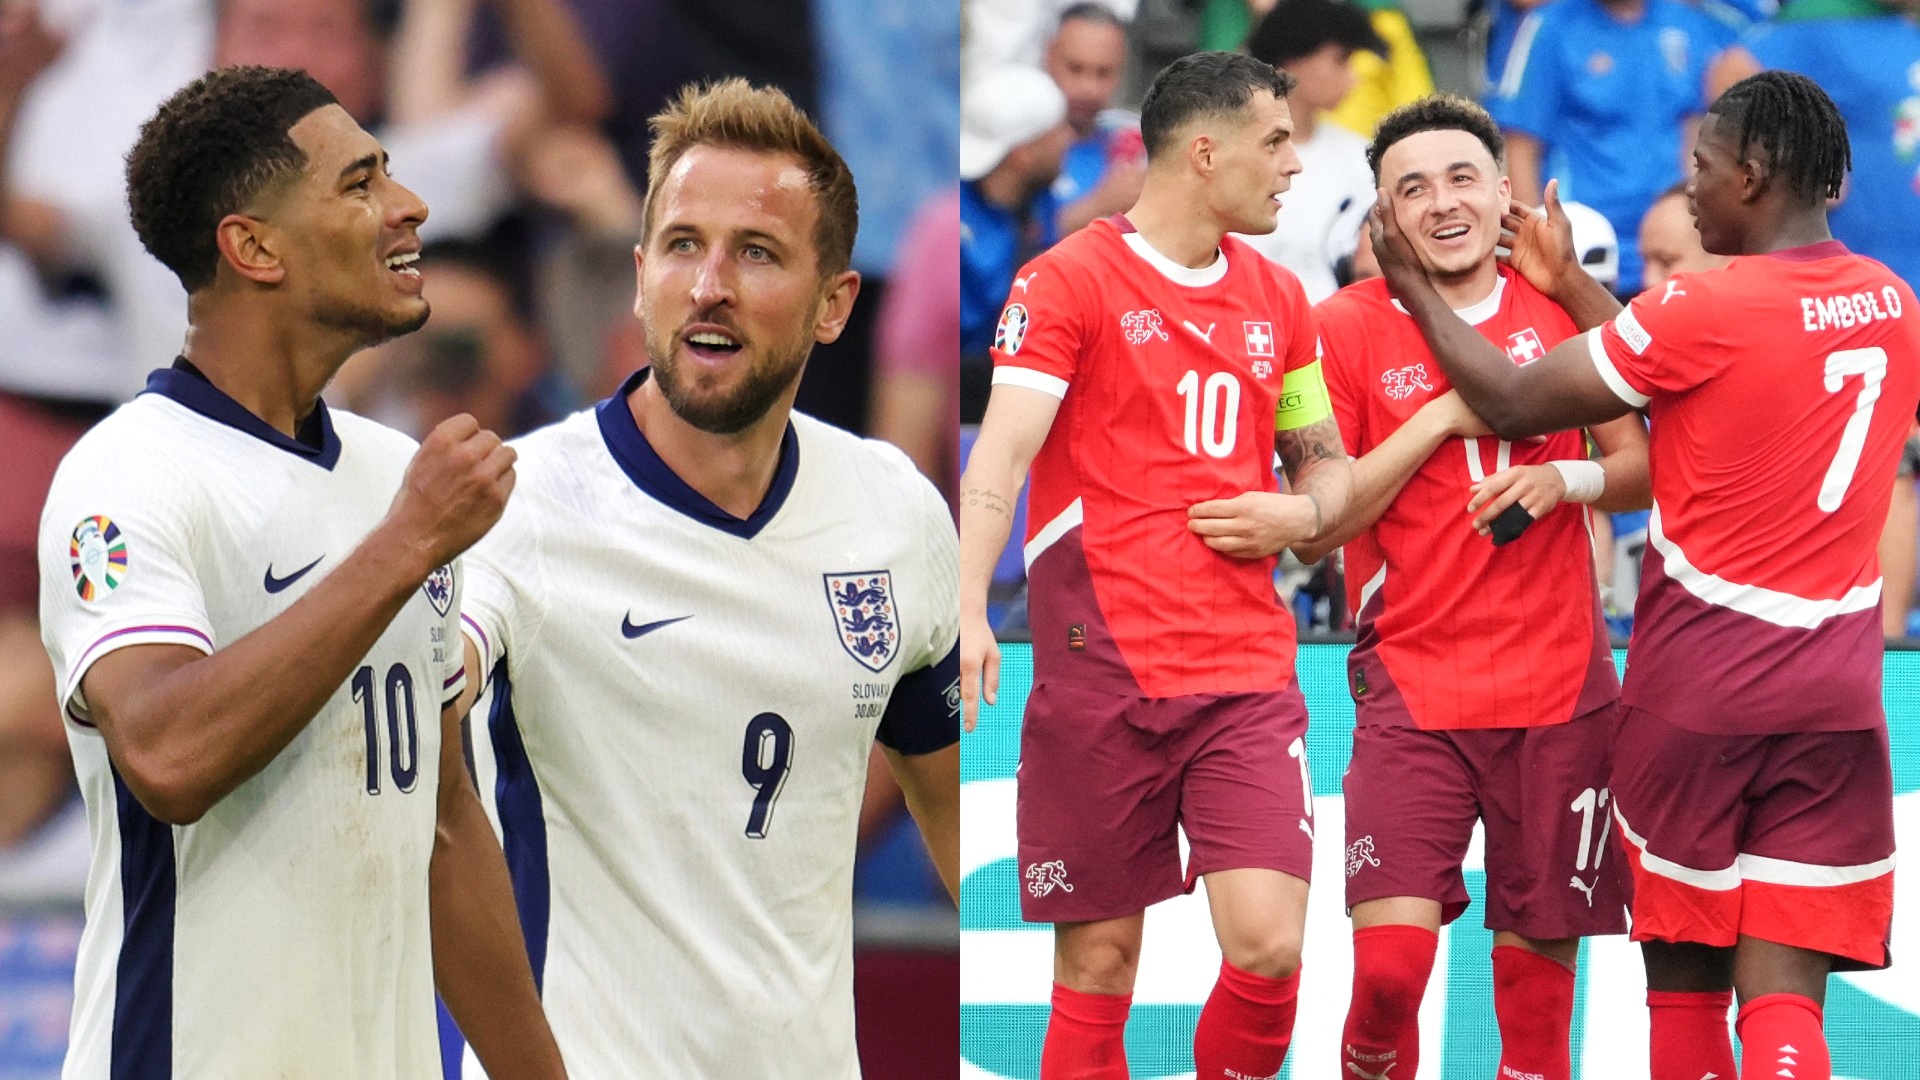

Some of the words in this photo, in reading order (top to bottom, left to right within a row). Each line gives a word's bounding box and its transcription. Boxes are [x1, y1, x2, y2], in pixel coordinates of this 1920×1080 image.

[1800, 285, 1902, 332] EMBOLO
[1176, 369, 1241, 459] 10
[1817, 346, 1889, 513] 7
[351, 662, 420, 796] 10
[741, 711, 796, 839] 9
